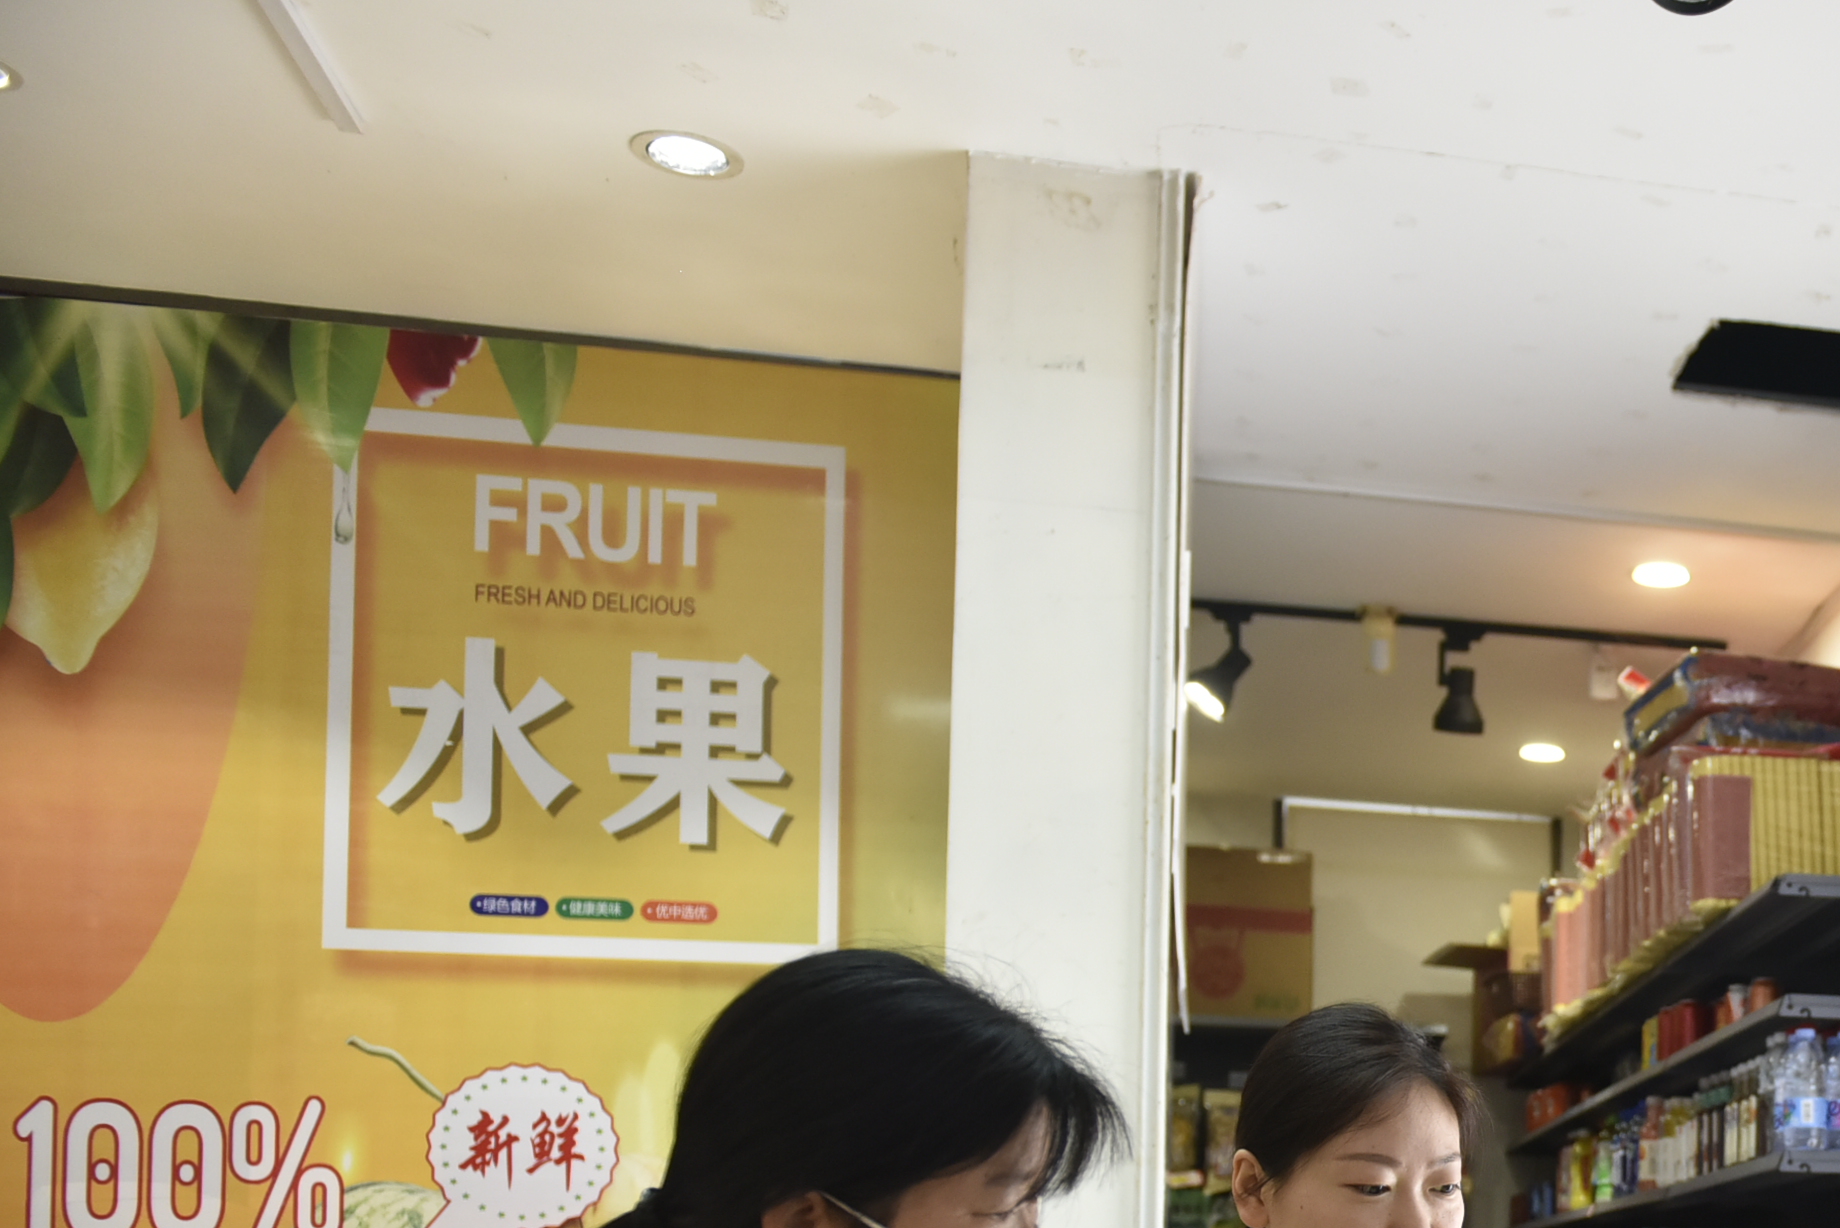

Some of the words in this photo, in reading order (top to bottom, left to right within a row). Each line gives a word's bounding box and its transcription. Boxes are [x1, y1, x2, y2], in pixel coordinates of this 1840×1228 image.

[473, 474, 718, 568] FRUIT
[475, 583, 542, 607] FRESH
[544, 588, 586, 610] AND
[592, 591, 696, 618] DELICIOUS
[376, 636, 789, 846] 水果
[458, 1107, 586, 1191] 新鲜
